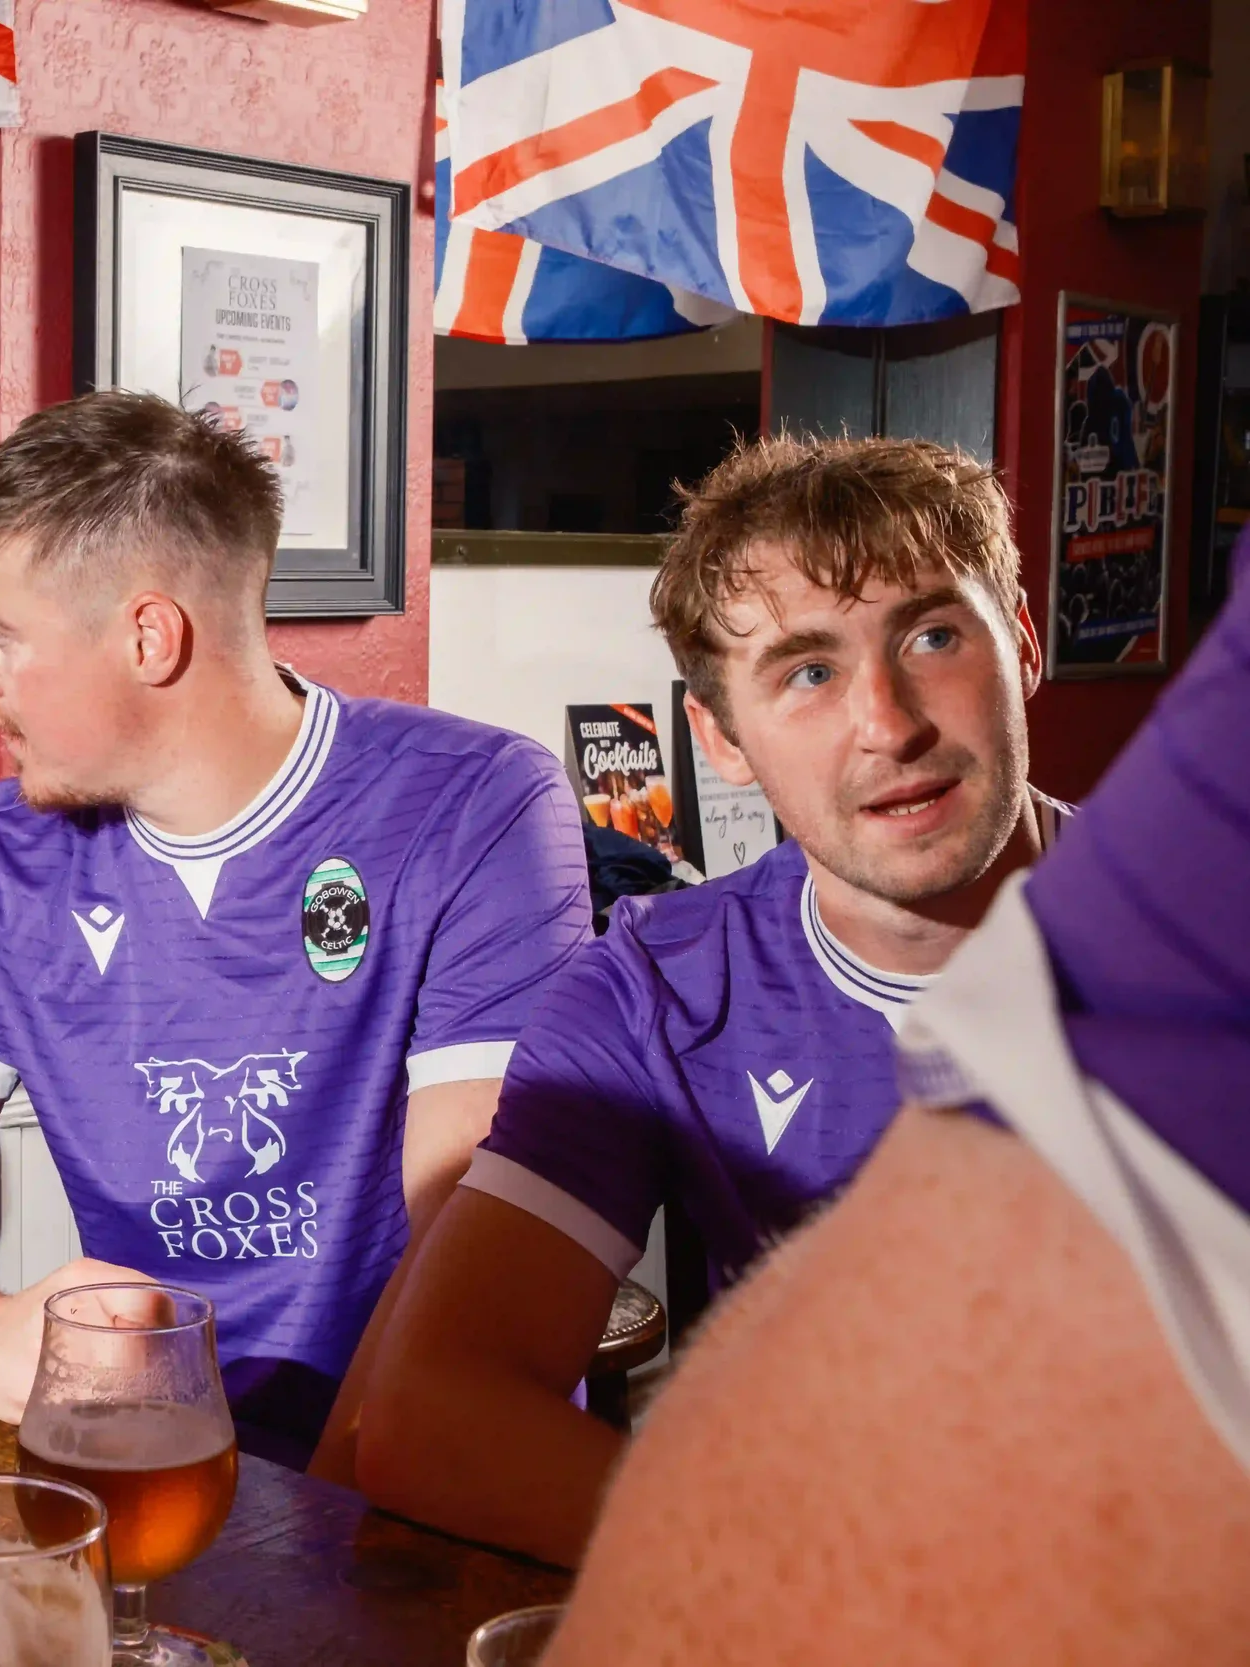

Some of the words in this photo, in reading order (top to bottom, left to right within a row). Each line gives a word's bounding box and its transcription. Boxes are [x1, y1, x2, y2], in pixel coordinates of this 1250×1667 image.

[228, 274, 277, 294] CROSS
[228, 290, 276, 310] FOXES
[215, 308, 258, 328] UPCOMING
[260, 313, 291, 332] EVENTS
[580, 721, 621, 738] CELEBRATE
[584, 741, 657, 779] Cocktails
[705, 806, 727, 838] along
[731, 802, 744, 824] the
[747, 810, 766, 833] way
[310, 886, 360, 913] GOBOWEN
[321, 935, 354, 950] CELTIC
[151, 1180, 183, 1195] THE
[150, 1181, 317, 1229] CROSS
[158, 1220, 318, 1260] FOXES
